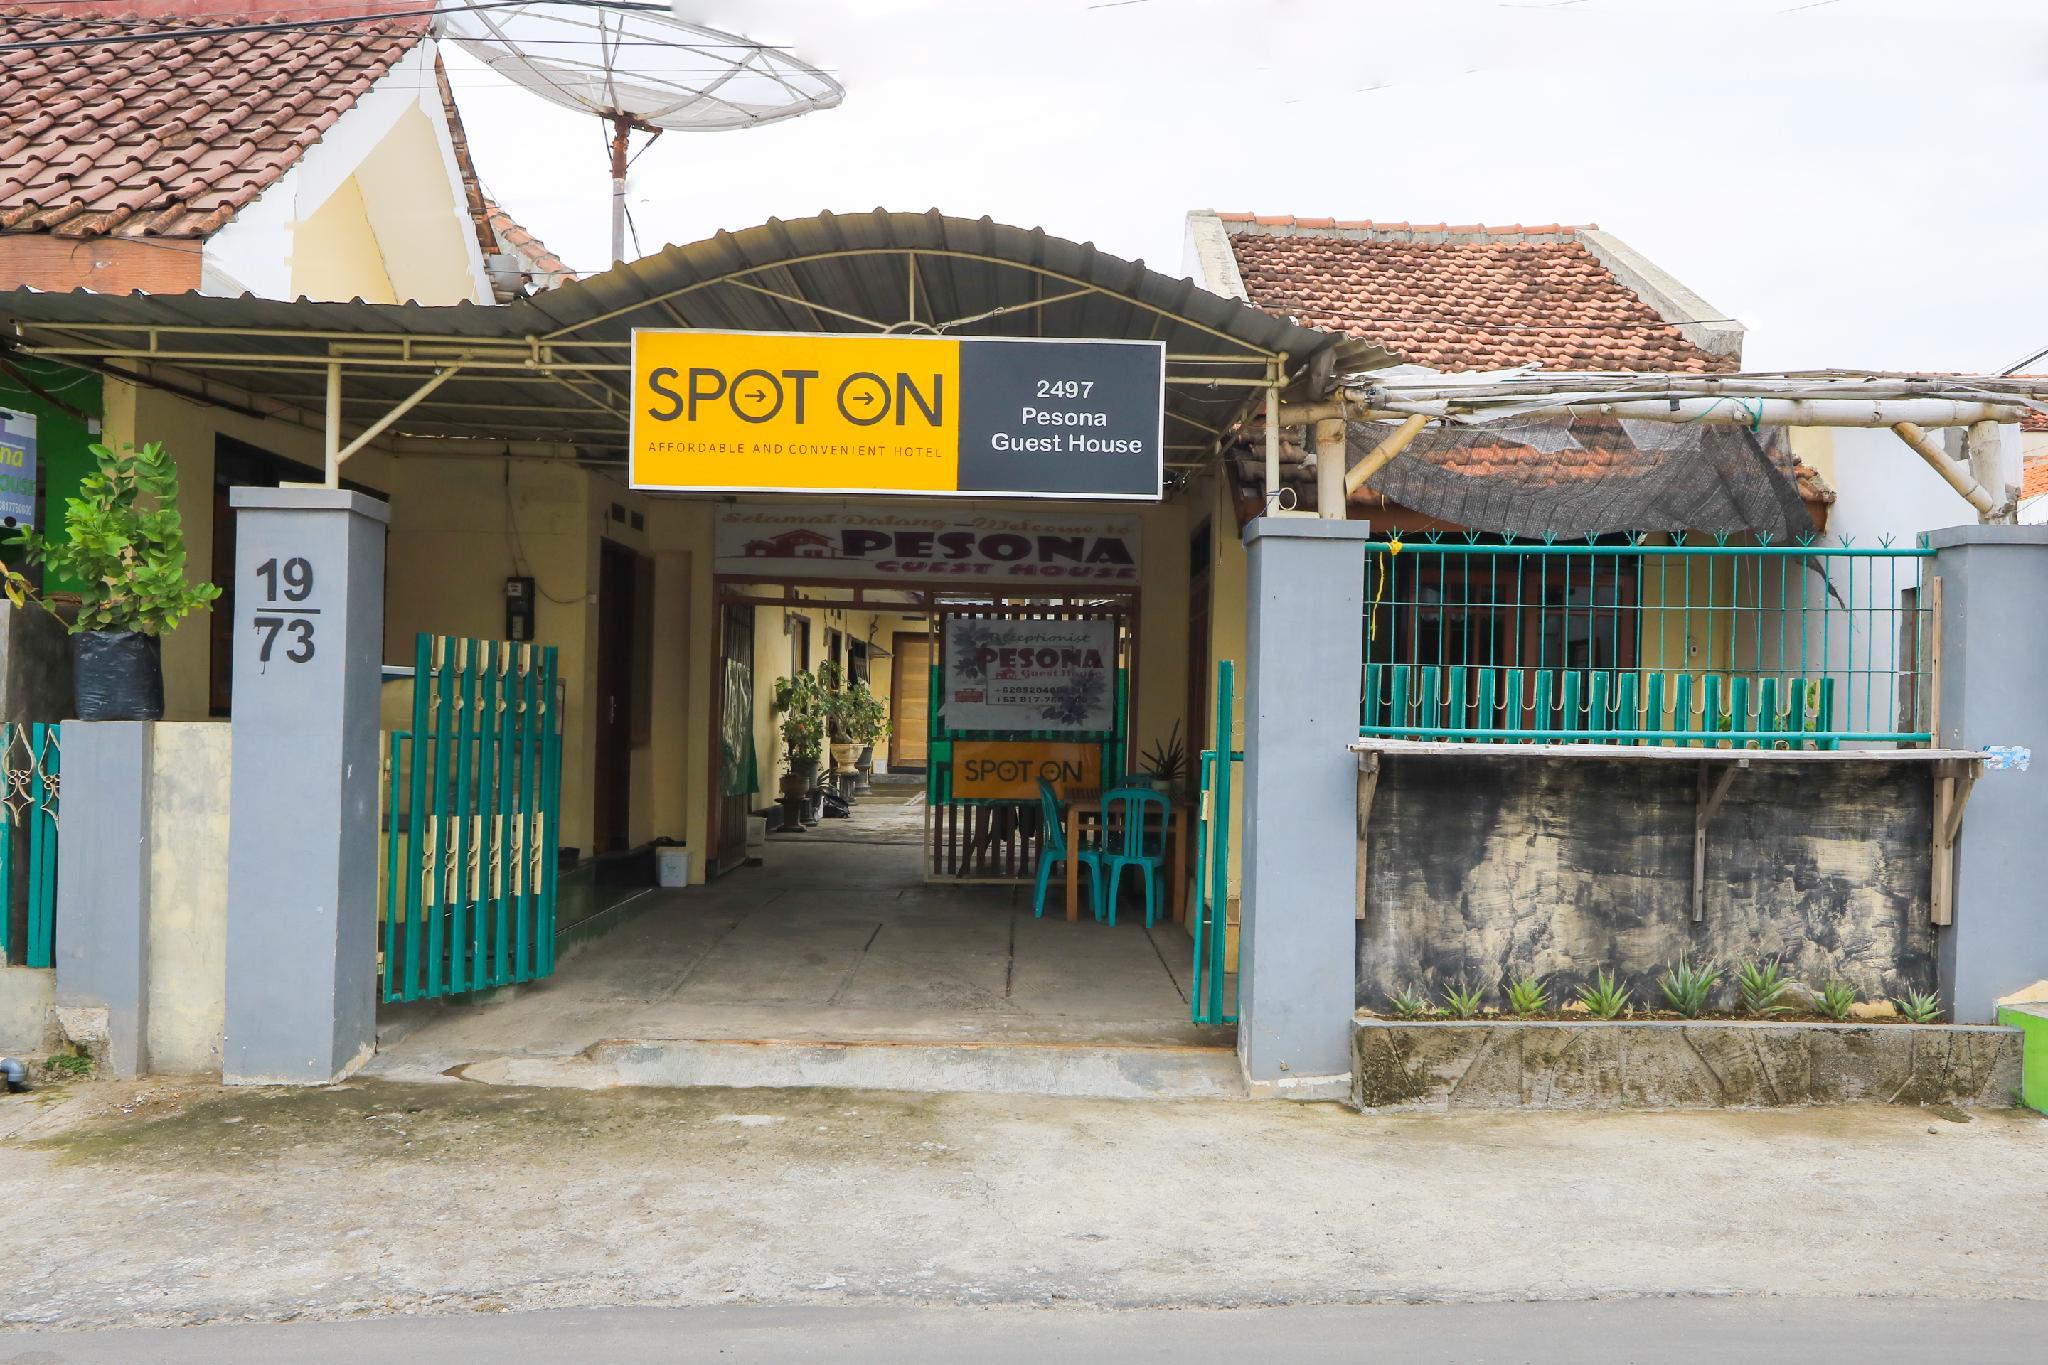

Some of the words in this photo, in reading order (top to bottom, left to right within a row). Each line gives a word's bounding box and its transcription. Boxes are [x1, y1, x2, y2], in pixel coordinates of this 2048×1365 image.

[648, 367, 819, 425] SPOT
[836, 371, 943, 427] ON
[1036, 379, 1095, 399] 2497
[1021, 406, 1108, 427] Pesona
[648, 441, 745, 455] AFFORDABLE
[752, 442, 784, 455] AND
[788, 443, 886, 457] CONVENIENT
[893, 446, 943, 459] HOTEL
[990, 432, 1063, 452] Guest
[1068, 433, 1143, 454] House
[721, 512, 835, 525] Selamat
[841, 513, 946, 530] Datang
[973, 517, 1094, 534] Welcome
[840, 529, 1135, 565] PESONA
[256, 556, 314, 602] 19
[874, 560, 995, 575] GUEST
[1007, 563, 1137, 579] HOUSE
[253, 617, 316, 665] 73
[976, 647, 1105, 669] PESONA
[965, 759, 1034, 783] SPOT
[1039, 760, 1083, 783] ON
